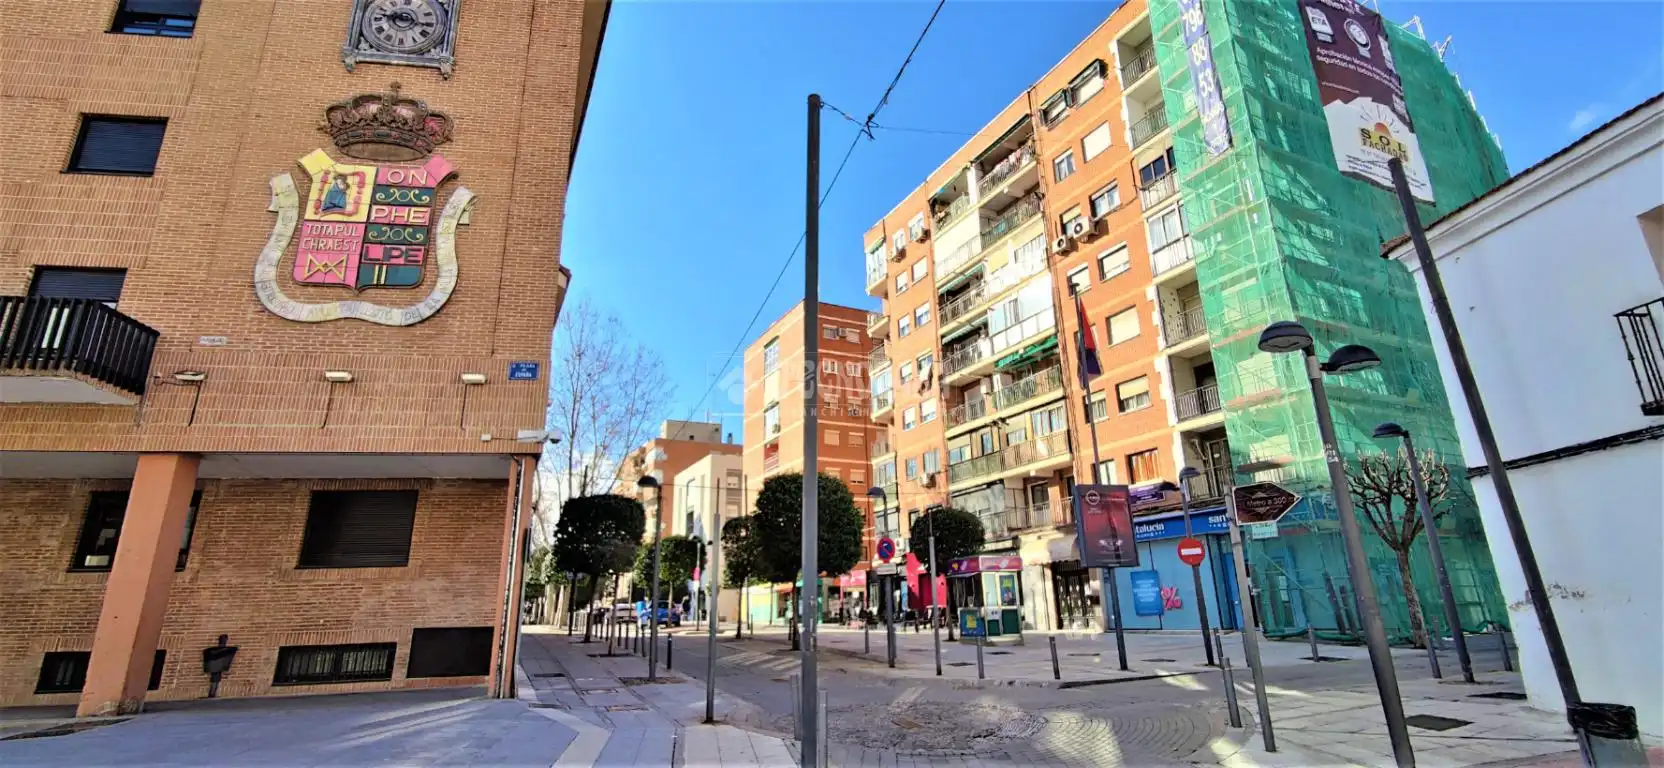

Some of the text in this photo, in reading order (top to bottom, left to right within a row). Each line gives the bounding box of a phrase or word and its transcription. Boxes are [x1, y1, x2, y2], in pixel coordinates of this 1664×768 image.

[1182, 3, 1204, 36] 796
[1191, 37, 1207, 66] 88
[1200, 67, 1214, 97] 53
[387, 169, 428, 185] ON
[371, 206, 430, 223] PHE
